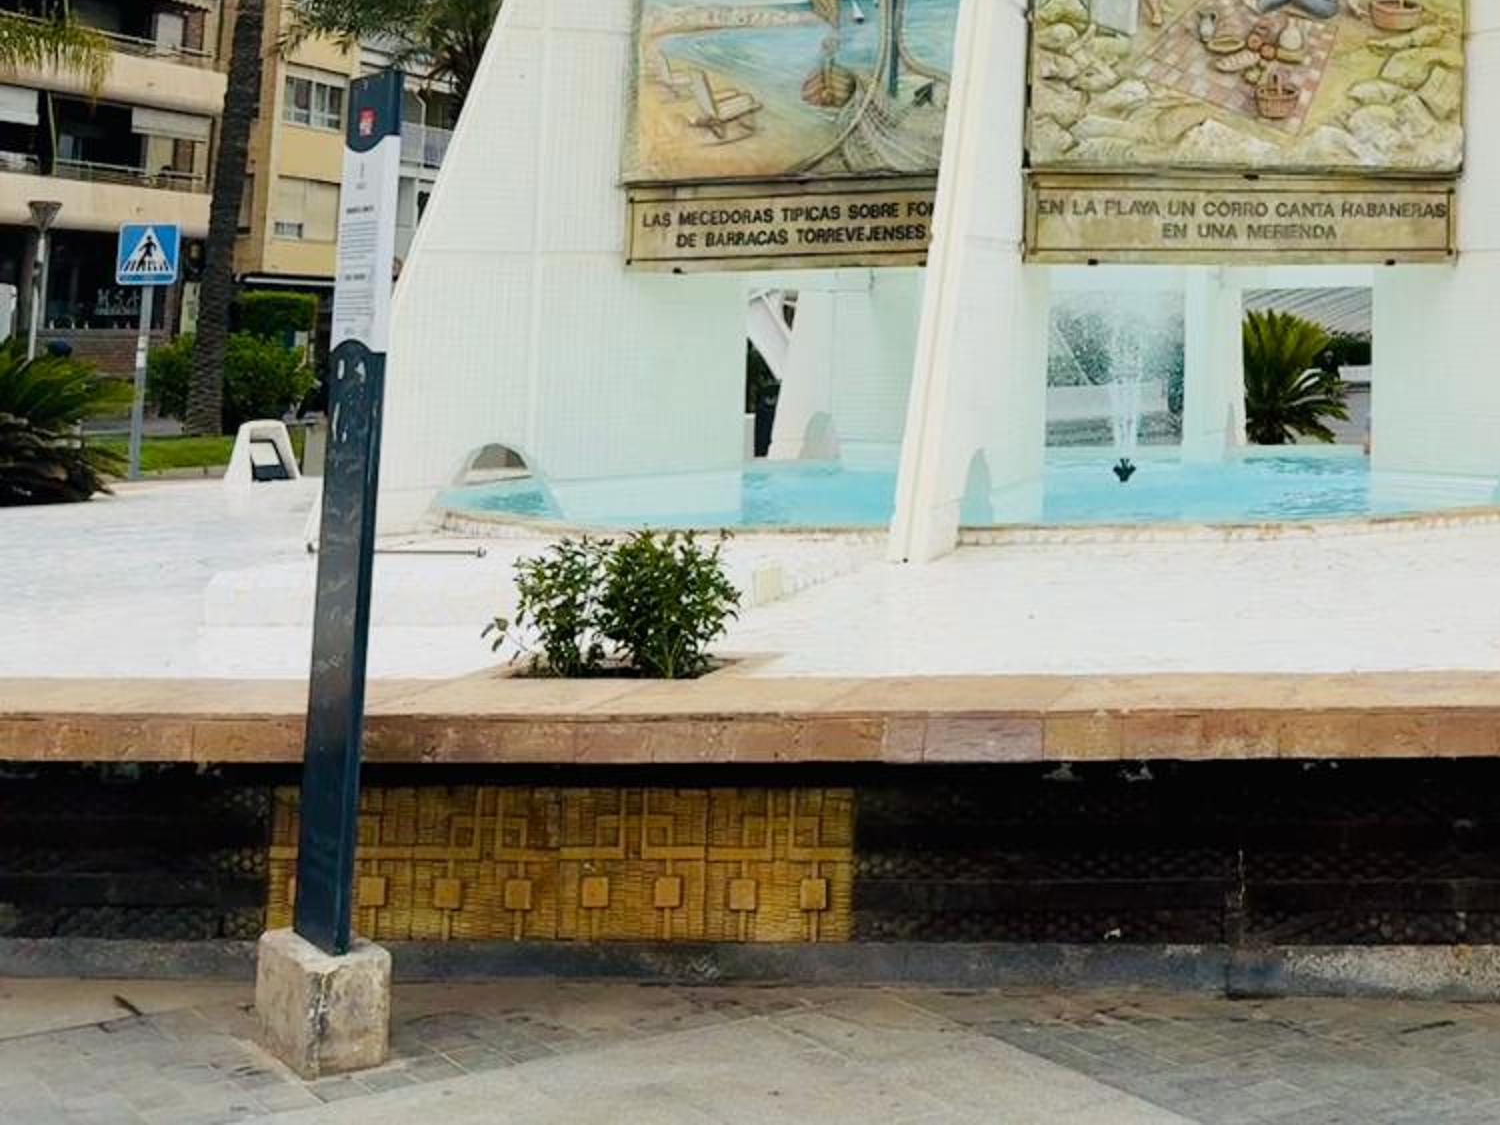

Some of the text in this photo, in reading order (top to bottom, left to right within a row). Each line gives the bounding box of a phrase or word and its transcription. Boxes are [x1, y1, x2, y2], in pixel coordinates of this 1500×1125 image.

[642, 212, 672, 228] LAS
[678, 207, 774, 226] MECEDORAS
[781, 203, 841, 222] TIPICAS
[848, 202, 900, 220] SOBRE
[1037, 200, 1064, 216] EN
[1072, 200, 1097, 216] LA
[1167, 201, 1195, 217] UN
[1203, 202, 1268, 218] CORRO
[1275, 202, 1335, 218] CANTA
[1341, 202, 1448, 219] HABANERAS
[675, 224, 927, 248] DE BARRACAS TORREVEJENSES
[1162, 223, 1337, 241] EN UNA MERIENDA
